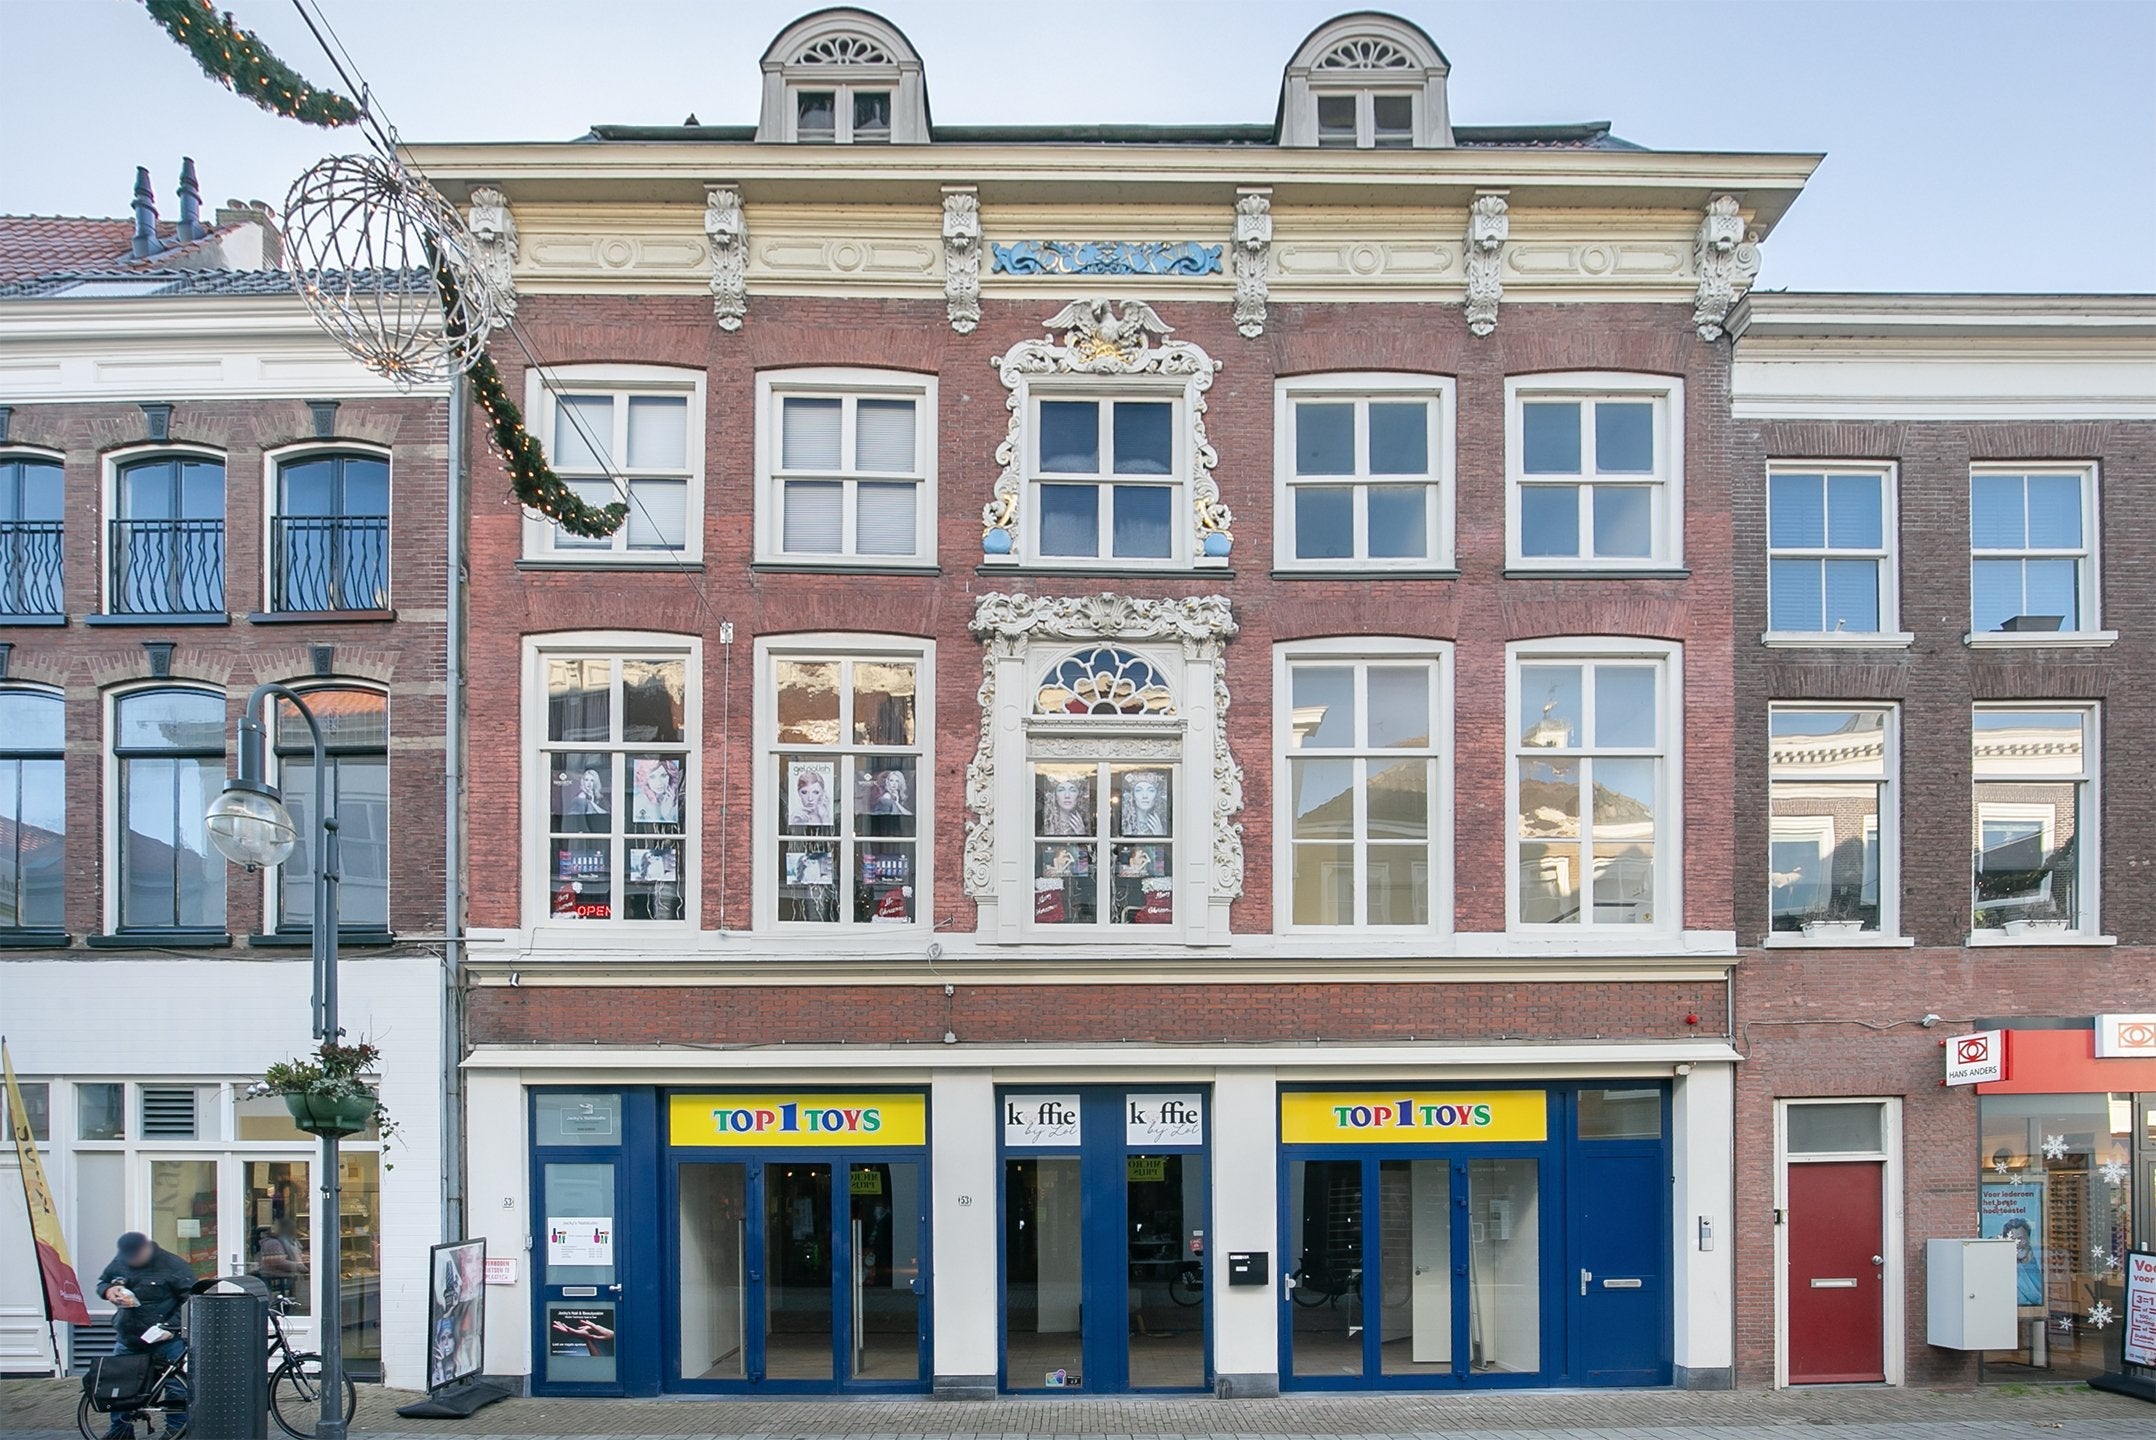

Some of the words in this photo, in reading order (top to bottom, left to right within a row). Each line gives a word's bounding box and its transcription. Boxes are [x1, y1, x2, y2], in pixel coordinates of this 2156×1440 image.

[577, 905, 611, 917] OPEN
[1949, 1069, 1968, 1079] HANS
[1969, 1065, 1998, 1076] ANDERS
[713, 1109, 776, 1132] TOP
[778, 1102, 800, 1132] 1
[804, 1109, 881, 1132] TOYS
[1007, 1101, 1076, 1125] kffie
[1129, 1100, 1198, 1124] kffie
[1334, 1106, 1392, 1127] TOP
[1395, 1099, 1415, 1127] 1
[1419, 1105, 1491, 1126] TOYS
[504, 1197, 513, 1207] 53
[961, 1195, 970, 1205] 53
[2133, 1275, 2155, 1284] voor
[2136, 1295, 2155, 1306] 3=1
